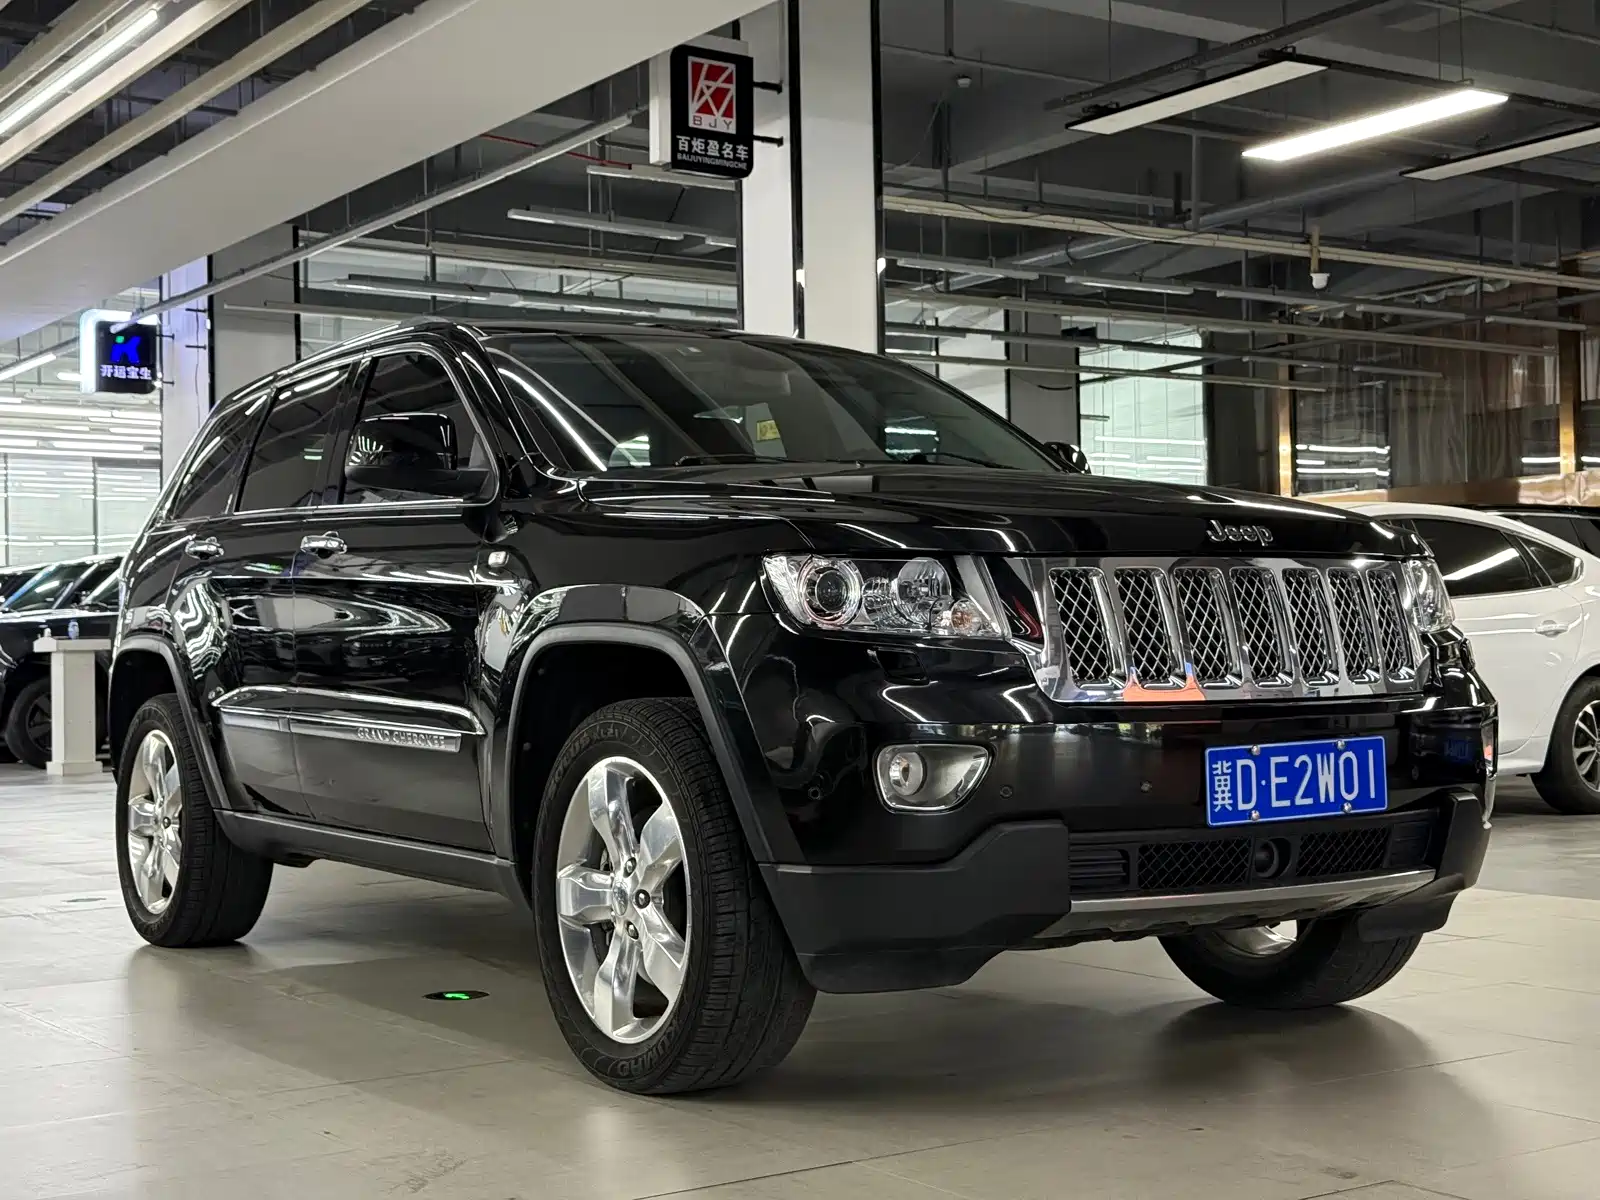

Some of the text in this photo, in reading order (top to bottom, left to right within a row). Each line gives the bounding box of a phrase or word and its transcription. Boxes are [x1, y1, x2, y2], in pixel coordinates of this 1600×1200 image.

[692, 115, 733, 131] BJY
[676, 135, 749, 160] 百炬盈名车
[1206, 519, 1274, 547] Jeep
[357, 727, 446, 749] GRAND CHEROKEE
[1212, 749, 1376, 812] 冀D·E2W01
